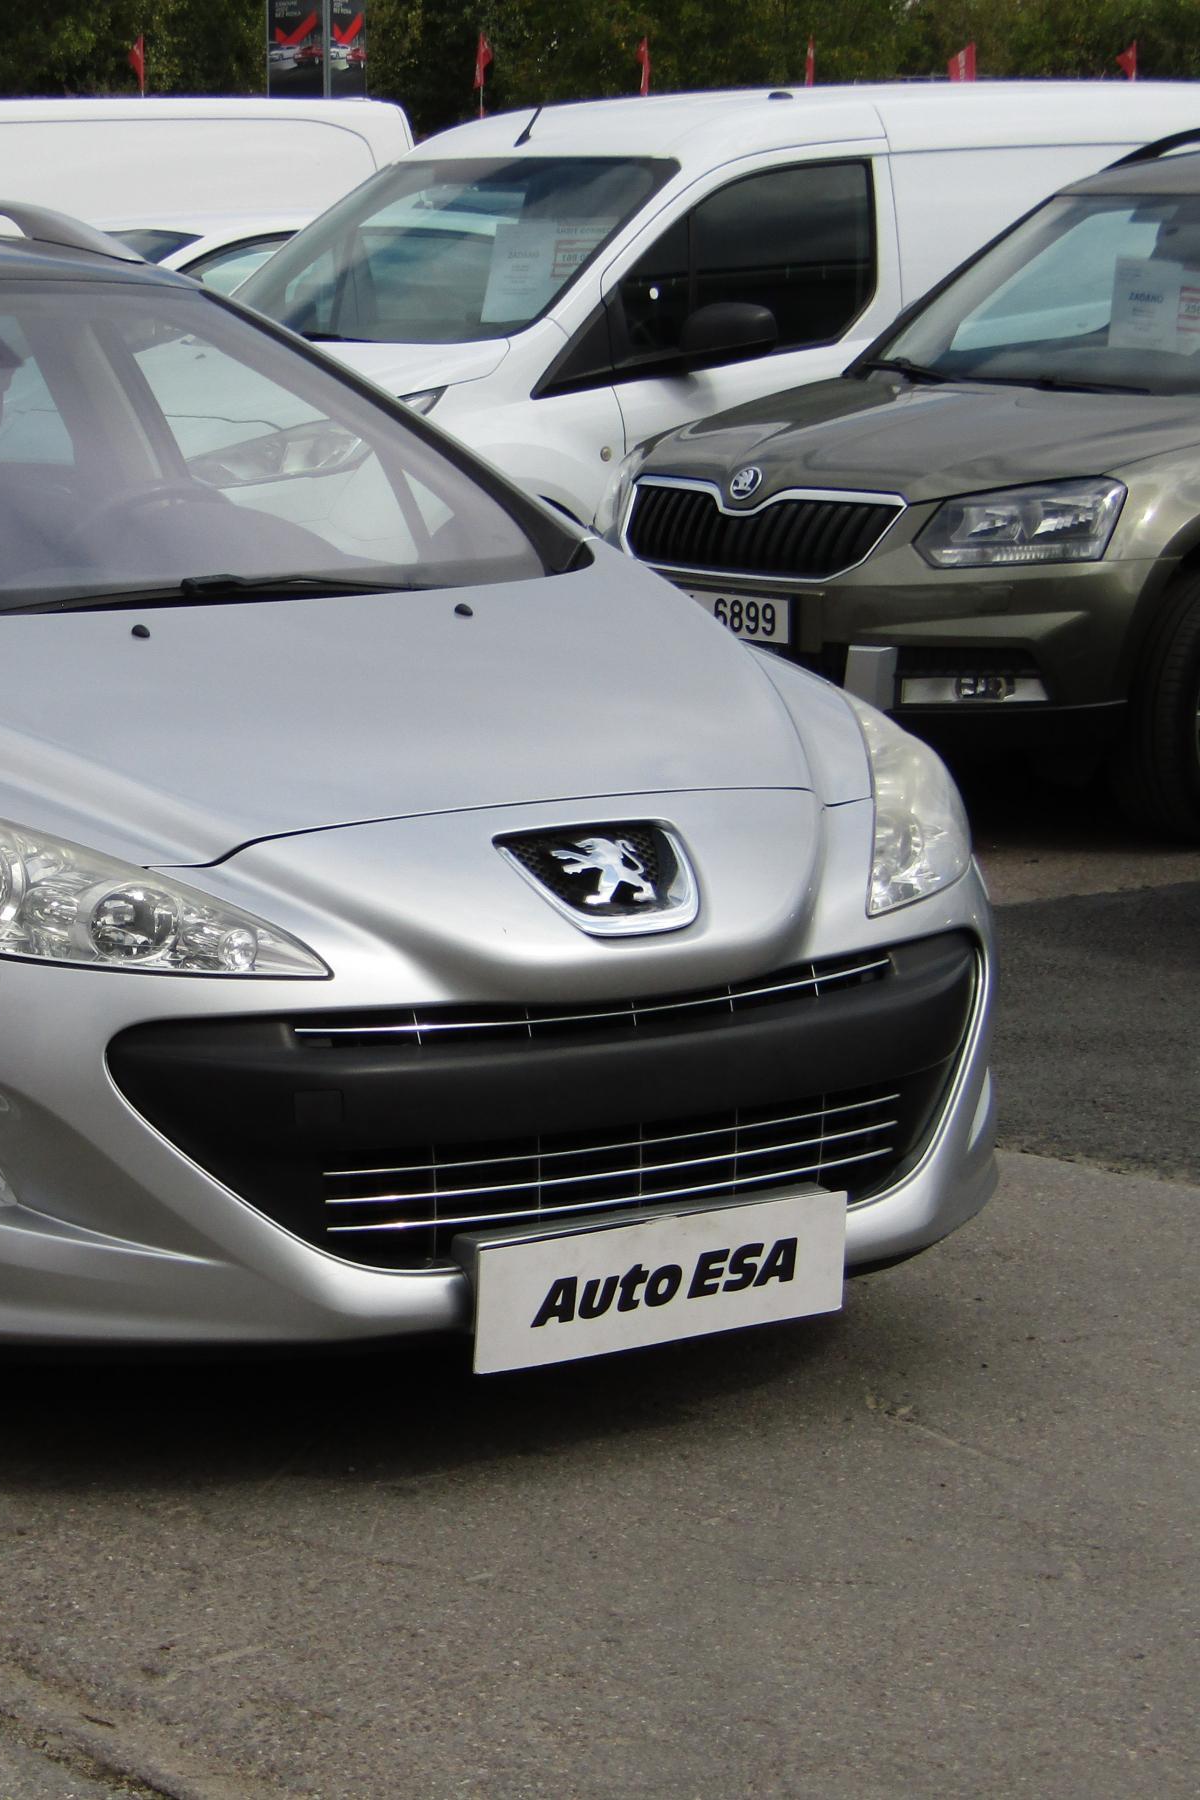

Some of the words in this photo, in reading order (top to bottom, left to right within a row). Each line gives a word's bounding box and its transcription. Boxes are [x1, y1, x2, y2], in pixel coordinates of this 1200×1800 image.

[714, 597, 776, 637] 6899
[530, 1263, 682, 1328] Auto
[687, 1237, 798, 1300] ESA
